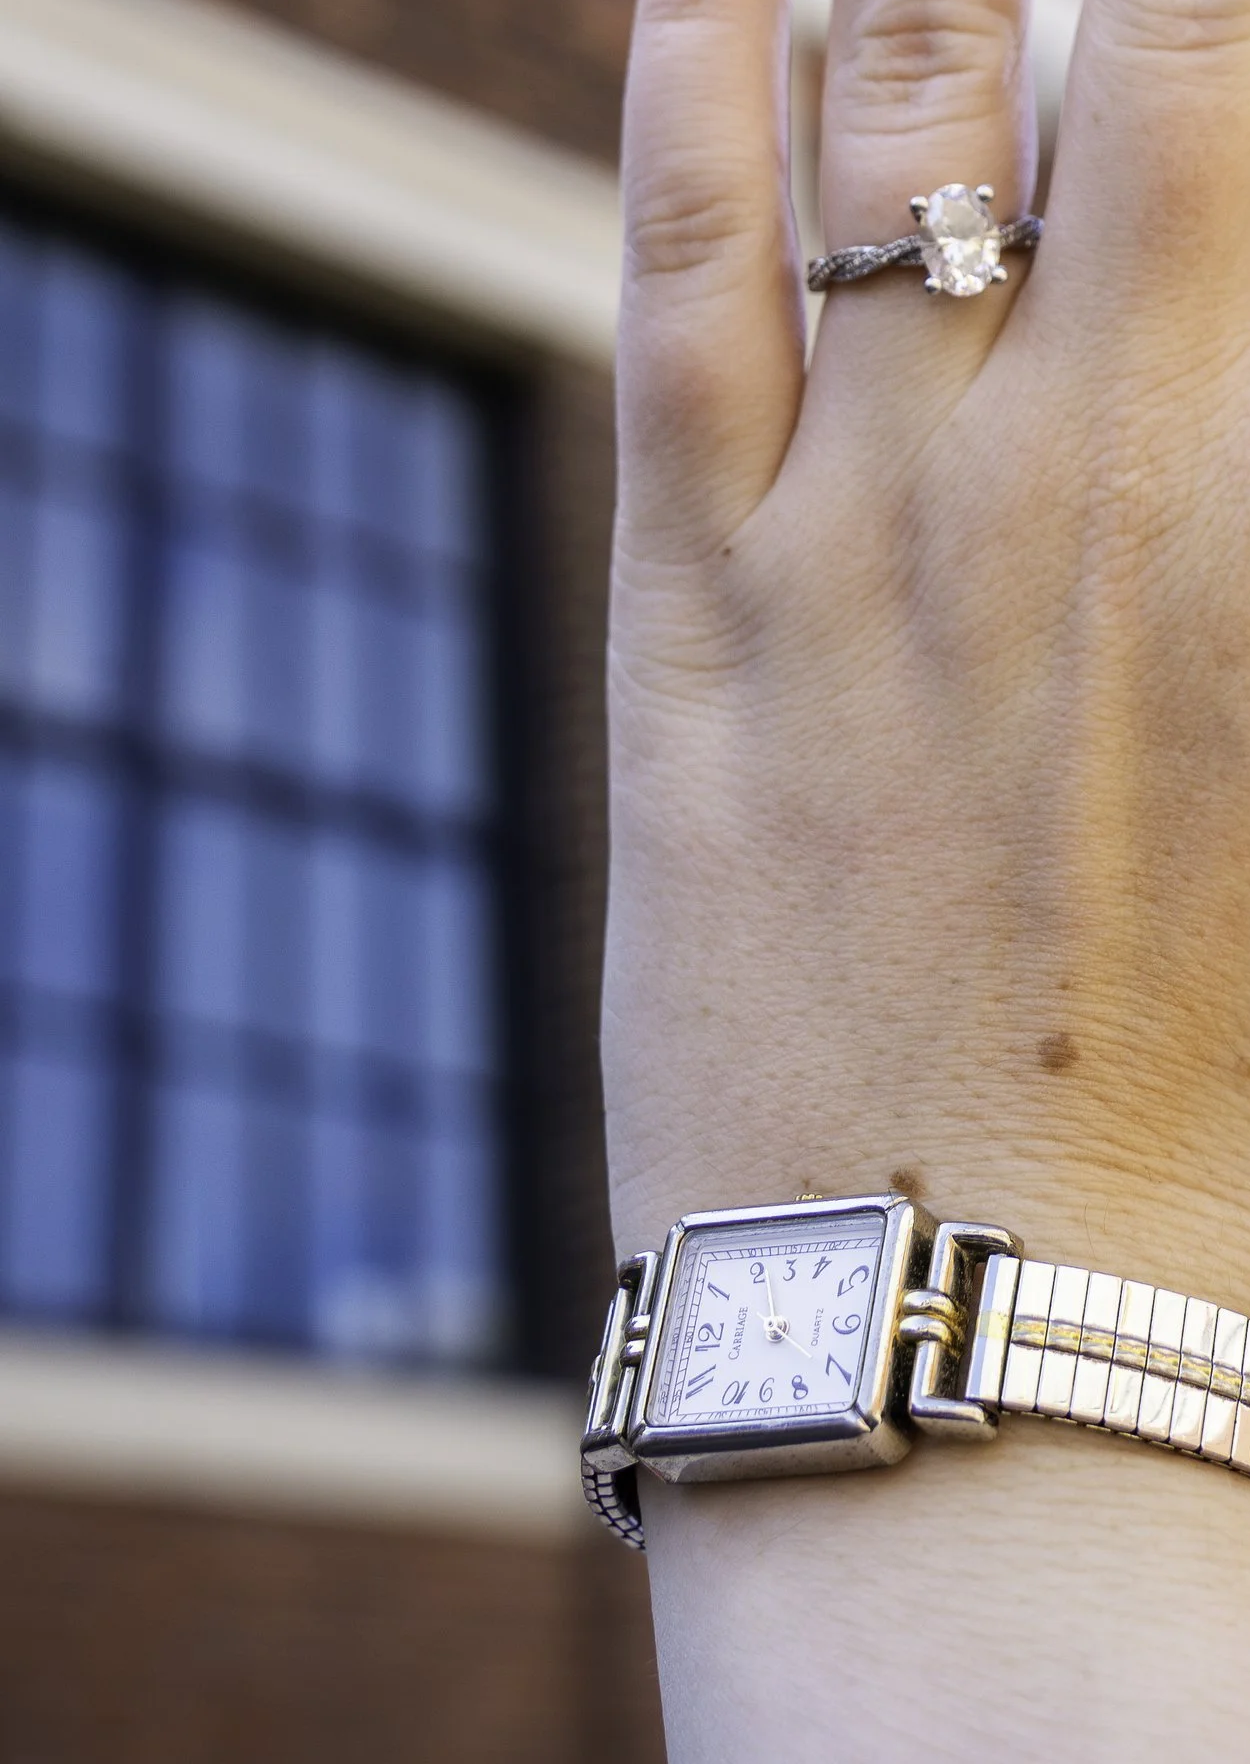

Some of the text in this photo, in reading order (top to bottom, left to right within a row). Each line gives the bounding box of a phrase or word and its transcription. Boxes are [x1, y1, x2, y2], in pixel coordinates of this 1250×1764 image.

[750, 1262, 765, 1284] 2
[783, 1258, 797, 1281] 3
[812, 1256, 832, 1279] 4
[707, 1282, 731, 1301] 1
[837, 1265, 870, 1297] 5
[695, 1322, 724, 1352] 12
[728, 1306, 748, 1360] CARRIAGE
[810, 1308, 824, 1348] QUARTZ
[832, 1314, 861, 1335] 6
[685, 1364, 717, 1400] 11
[826, 1353, 852, 1386] 7
[721, 1381, 749, 1406] 10
[792, 1375, 808, 1400] 8
